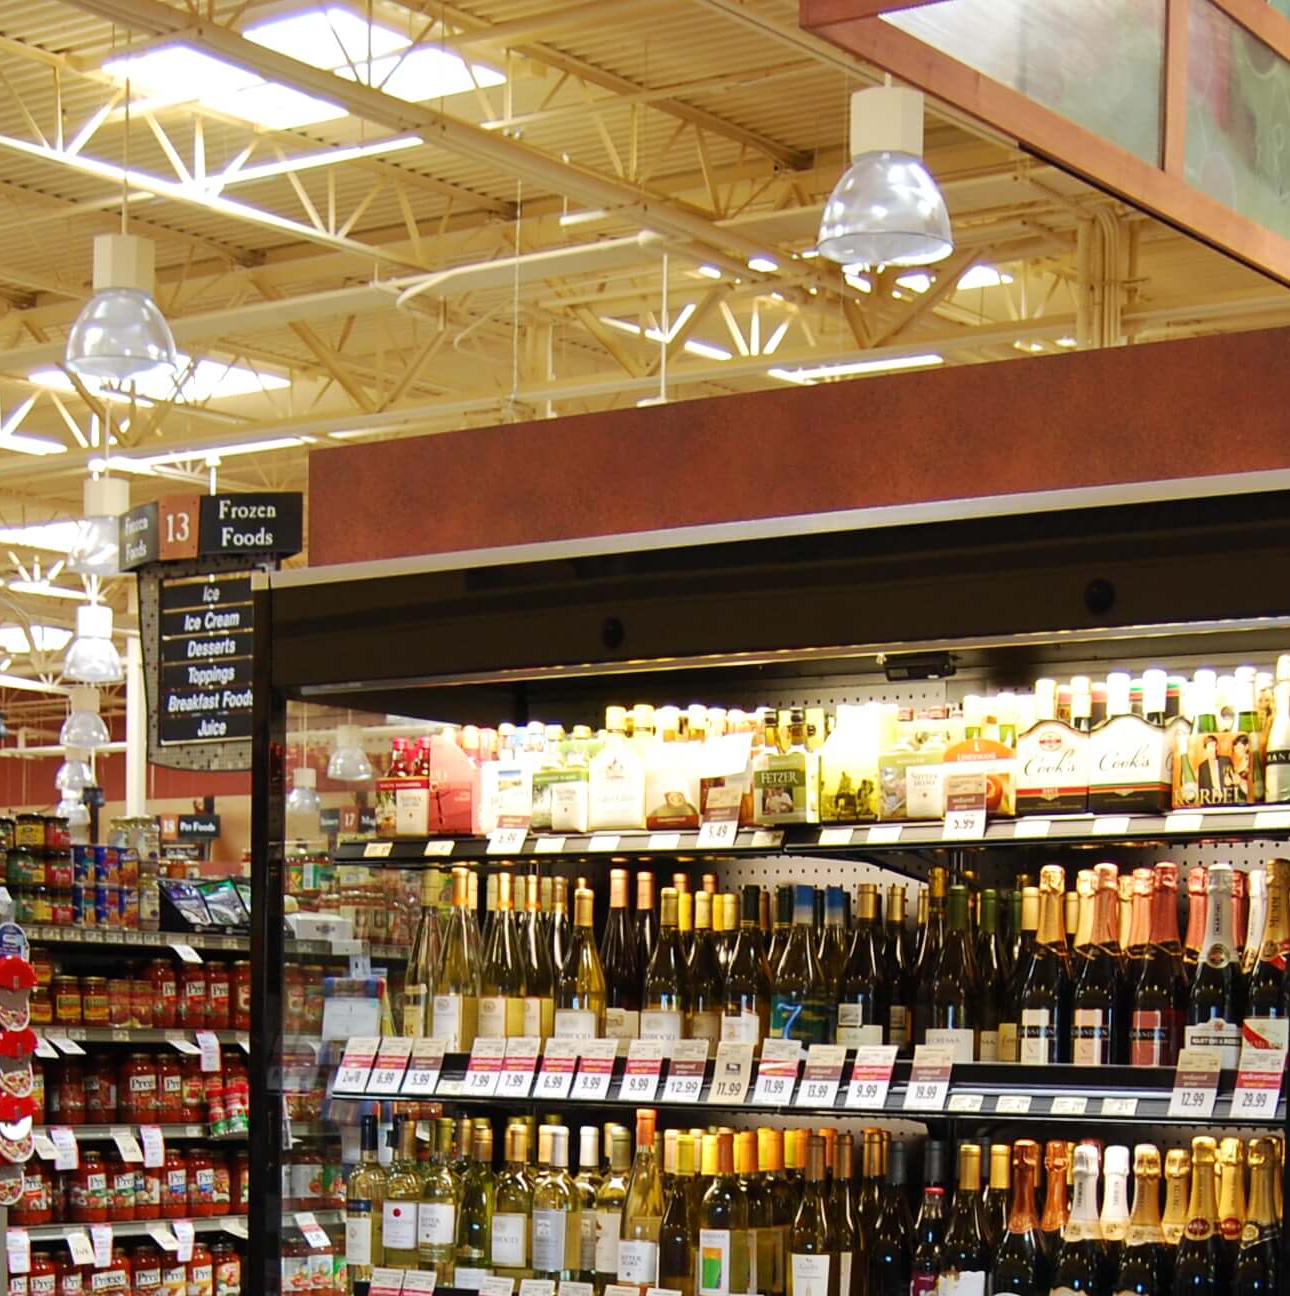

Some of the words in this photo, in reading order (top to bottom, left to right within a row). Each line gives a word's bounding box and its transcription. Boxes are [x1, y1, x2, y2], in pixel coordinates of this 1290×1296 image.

[218, 500, 277, 520] Frozen
[166, 513, 190, 543] 13
[221, 527, 274, 547] Foods
[202, 586, 220, 602] Ice
[184, 614, 201, 632] Ice
[204, 611, 240, 630] Cream
[187, 638, 236, 658] Desserts
[187, 665, 235, 686] Toppings
[168, 692, 219, 714] Breakfast
[197, 719, 227, 738] Juice
[761, 772, 799, 785] FETZER
[670, 1081, 699, 1094] 12.99
[716, 1081, 742, 1097] 11.99
[1181, 1092, 1205, 1107] 12.99
